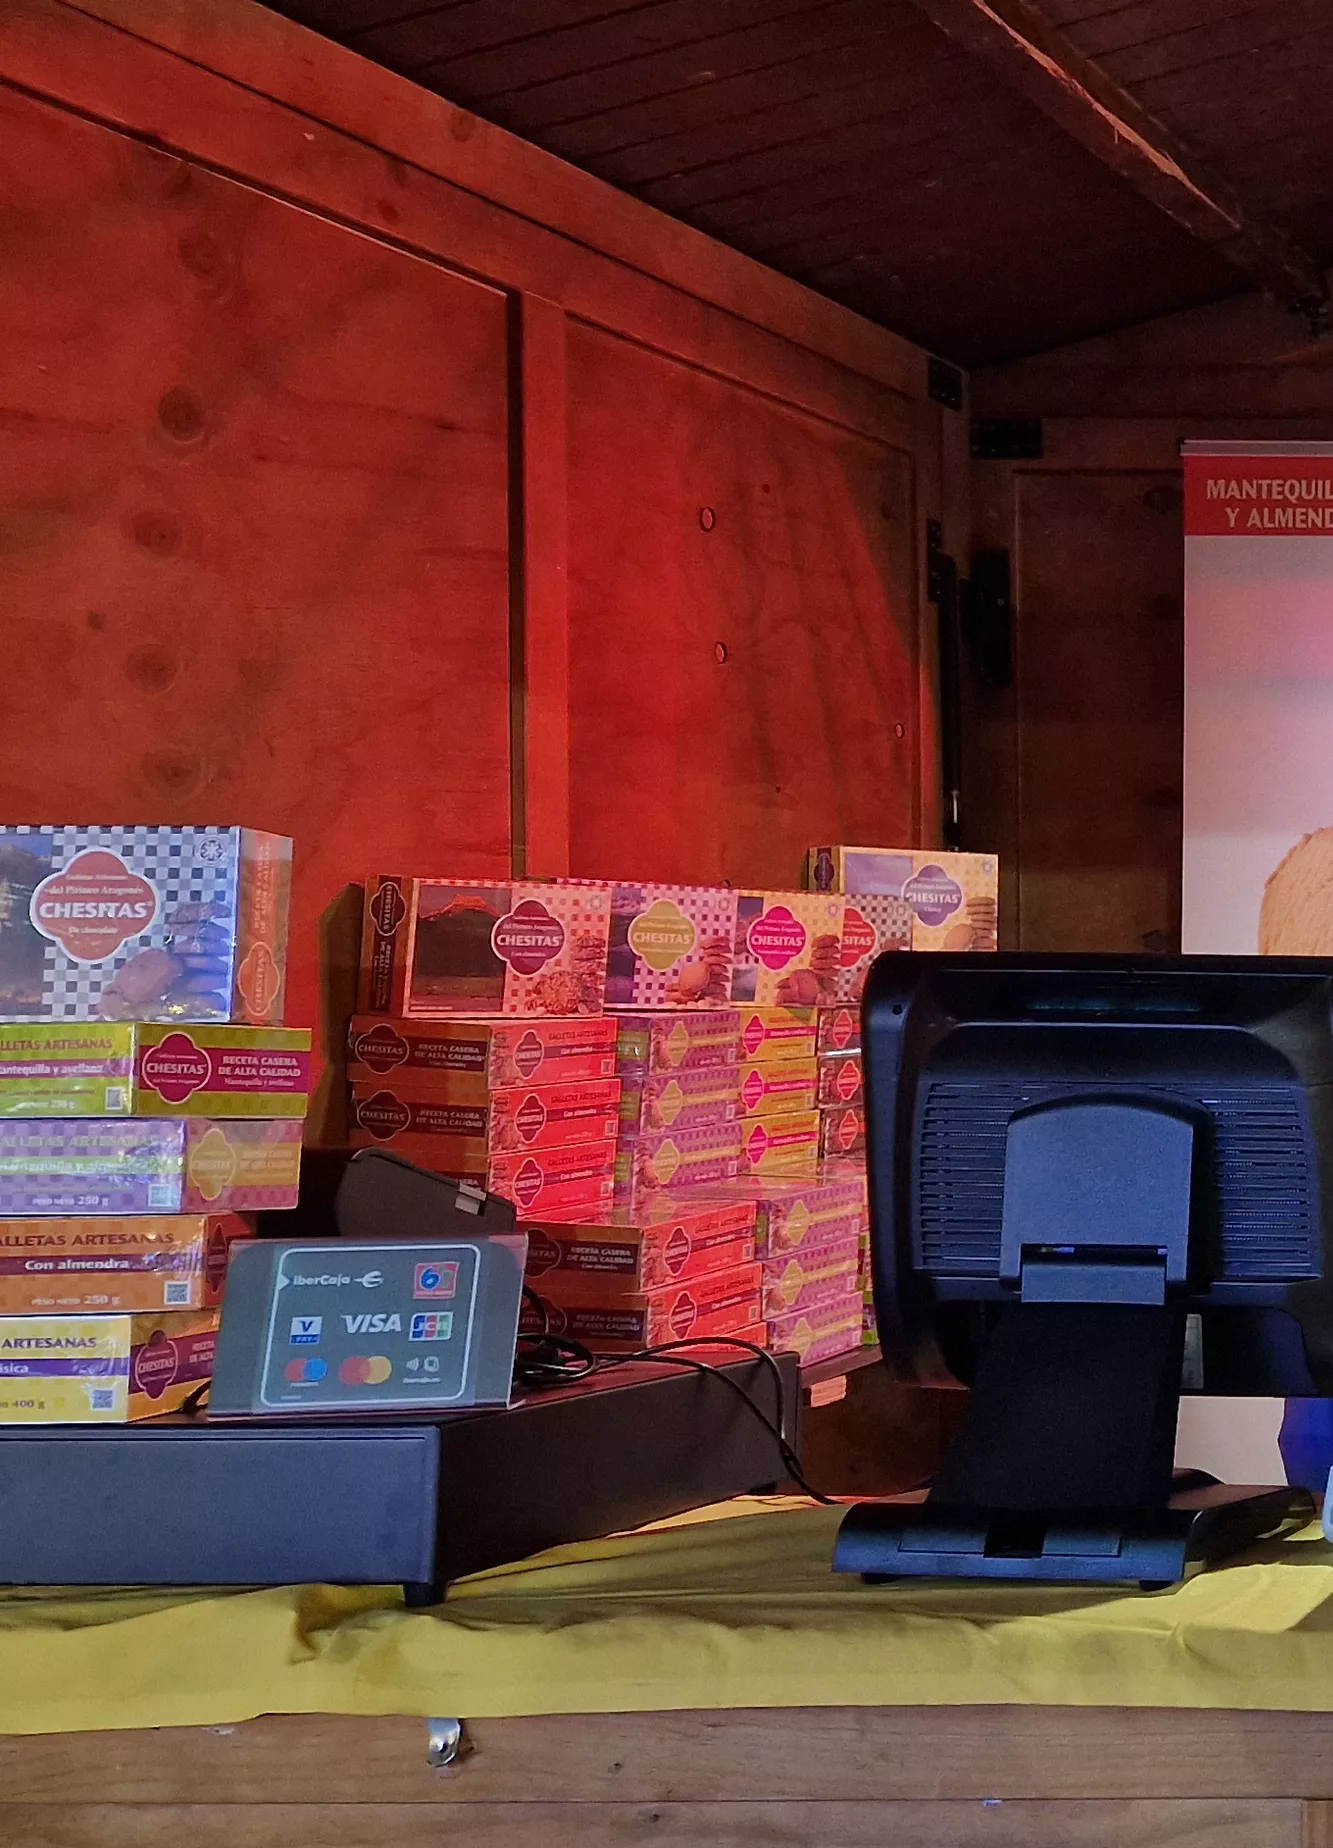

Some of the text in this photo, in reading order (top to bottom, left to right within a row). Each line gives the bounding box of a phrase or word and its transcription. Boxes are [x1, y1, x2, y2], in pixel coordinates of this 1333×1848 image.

[1225, 507, 1240, 528] Y
[842, 936, 873, 946] SITAS
[222, 1055, 298, 1066] RECETA CASERA
[218, 1066, 301, 1077] DE ALTA CALIDAD
[0, 1233, 175, 1247] LLETAS ARTESANAS
[24, 1258, 130, 1271] Con almendra
[340, 1313, 402, 1334] VISA
[2, 1337, 97, 1348] ARTESANAS
